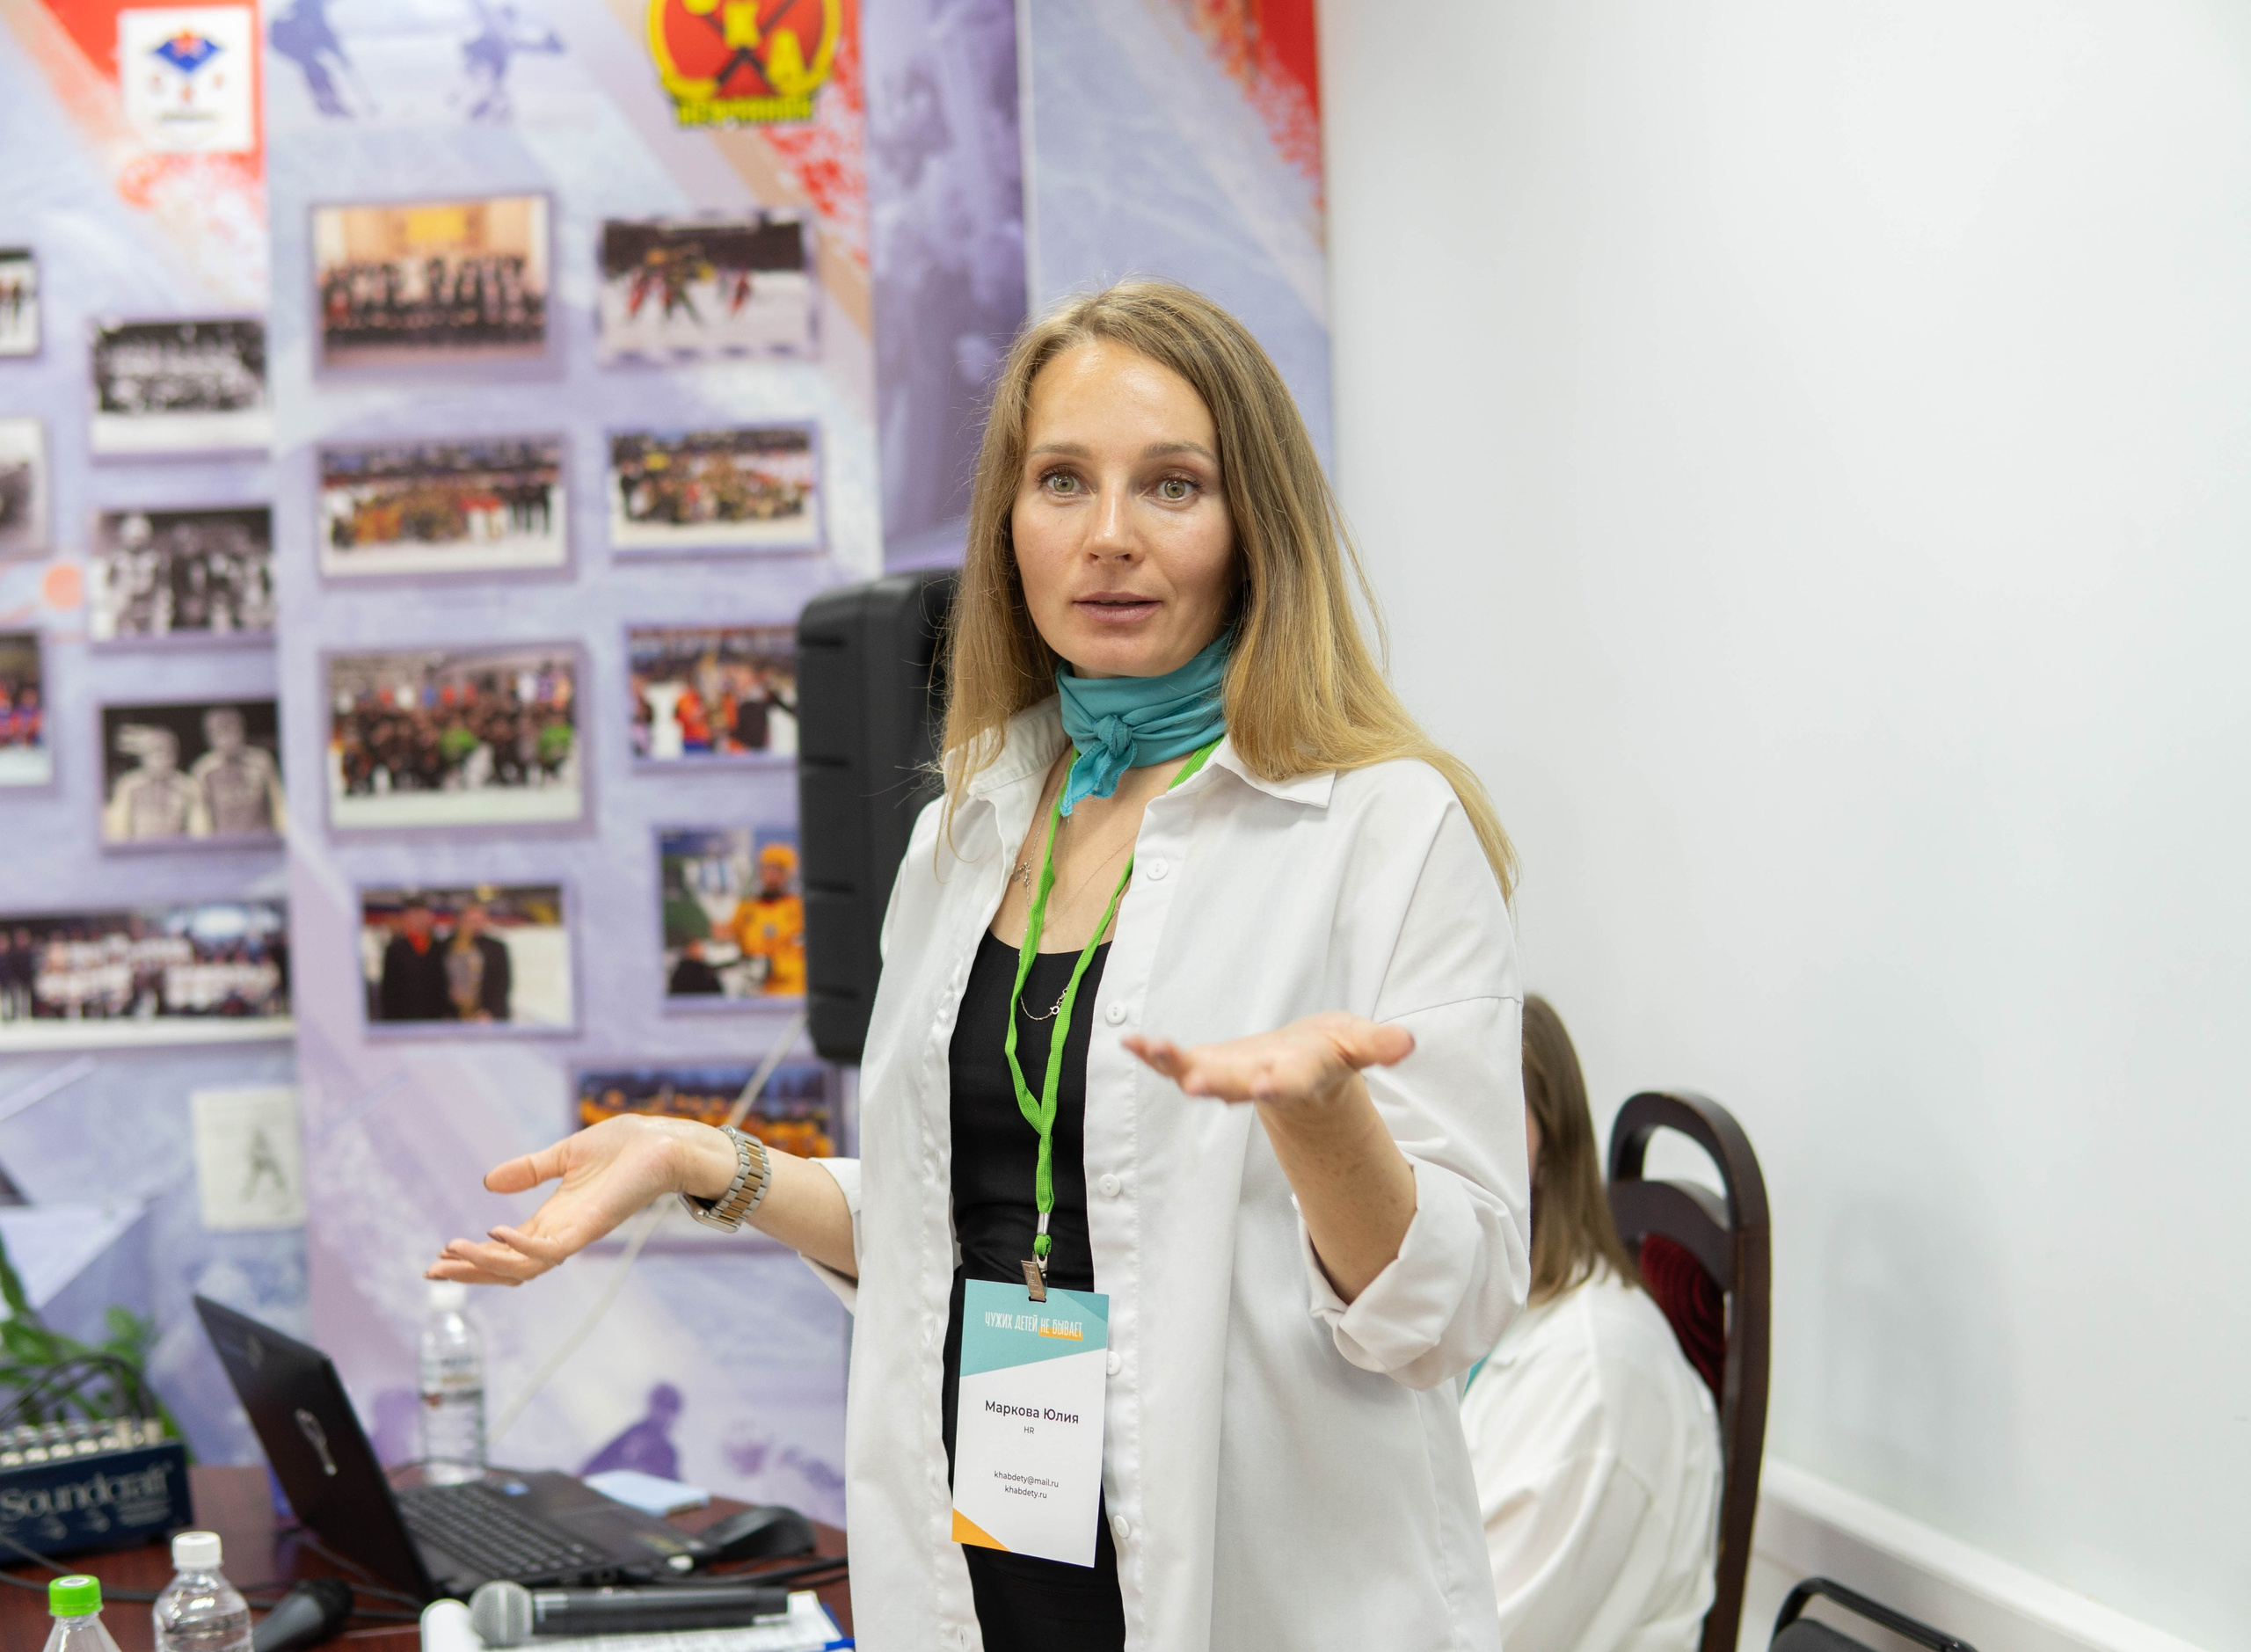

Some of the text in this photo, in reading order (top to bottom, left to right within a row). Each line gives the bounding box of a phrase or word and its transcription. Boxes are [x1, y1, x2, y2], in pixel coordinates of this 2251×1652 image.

[985, 1311, 1082, 1338] ЧУЖИХ ДЕТЕЙ НЕ БЫВАЕТ
[985, 1400, 1079, 1424] Маркова Юлия
[1024, 1425, 1035, 1435] HR
[994, 1470, 1059, 1488] khabdety@mail.ru
[1004, 1485, 1047, 1499] khabdety.ru
